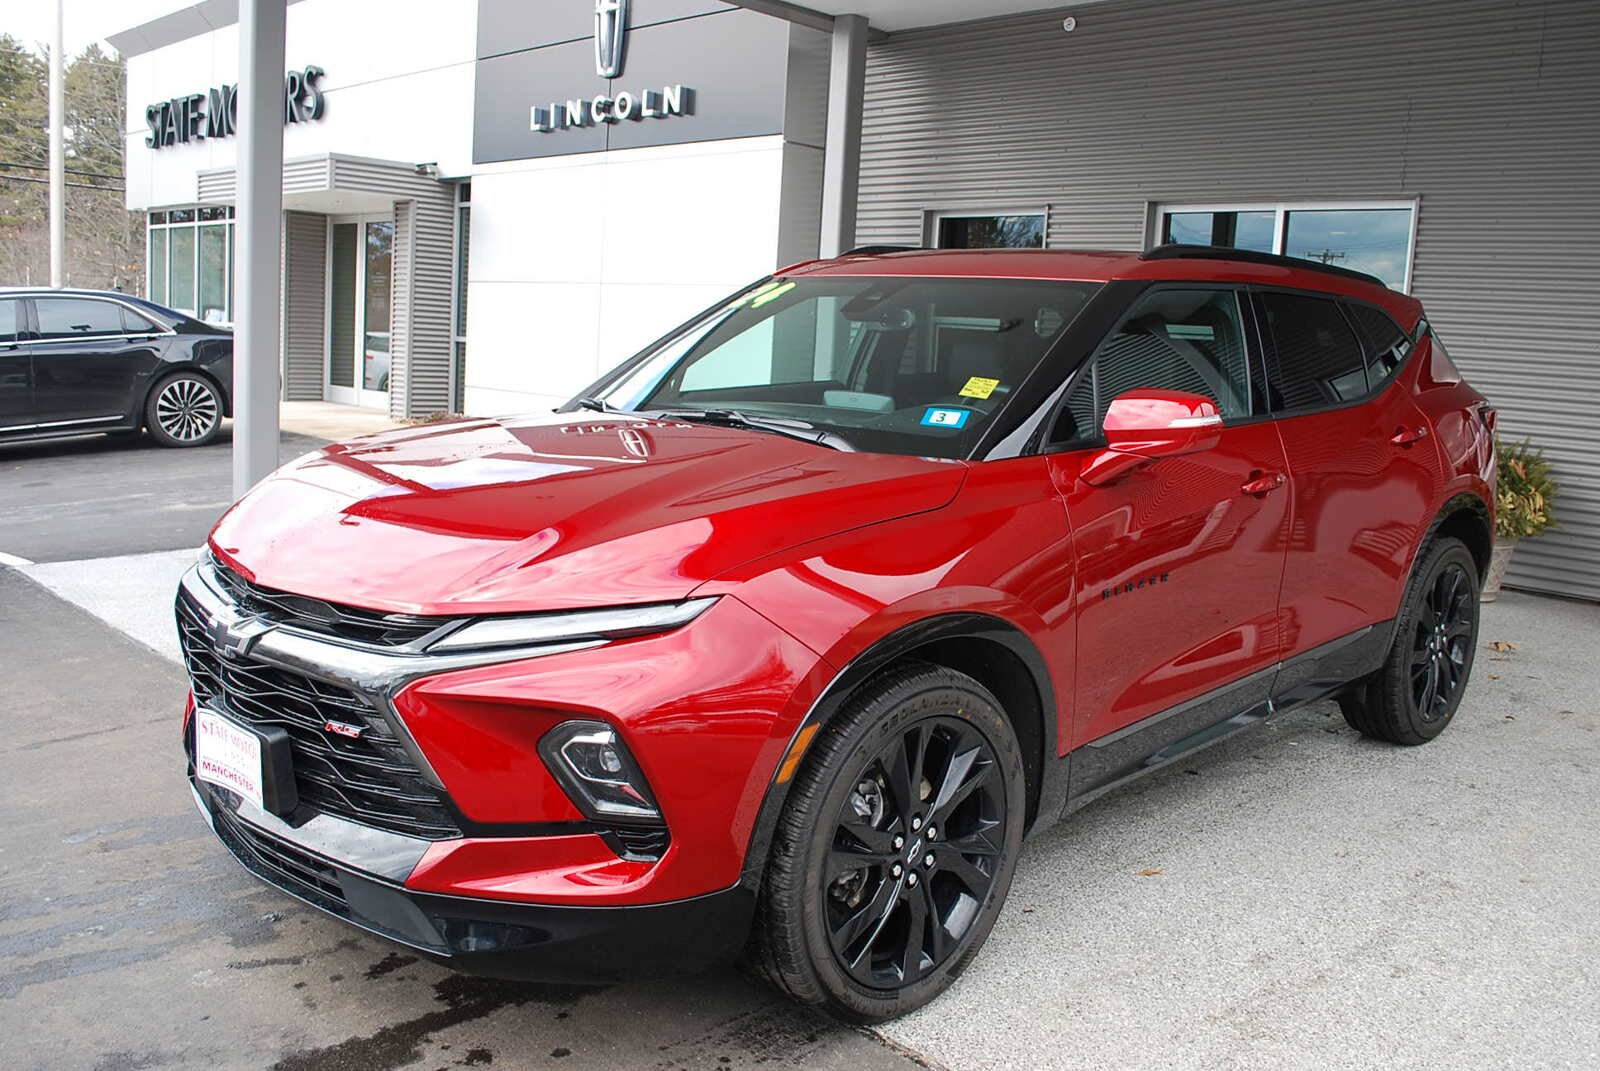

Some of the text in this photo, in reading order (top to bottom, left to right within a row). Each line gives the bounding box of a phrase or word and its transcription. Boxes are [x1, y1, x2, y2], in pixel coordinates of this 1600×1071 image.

[145, 94, 205, 149] STATE
[530, 85, 696, 133] LINCOLN
[936, 412, 947, 423] 3
[1102, 572, 1169, 600] BLAZER
[324, 719, 361, 739] RS
[201, 759, 254, 793] MANCHESTER
